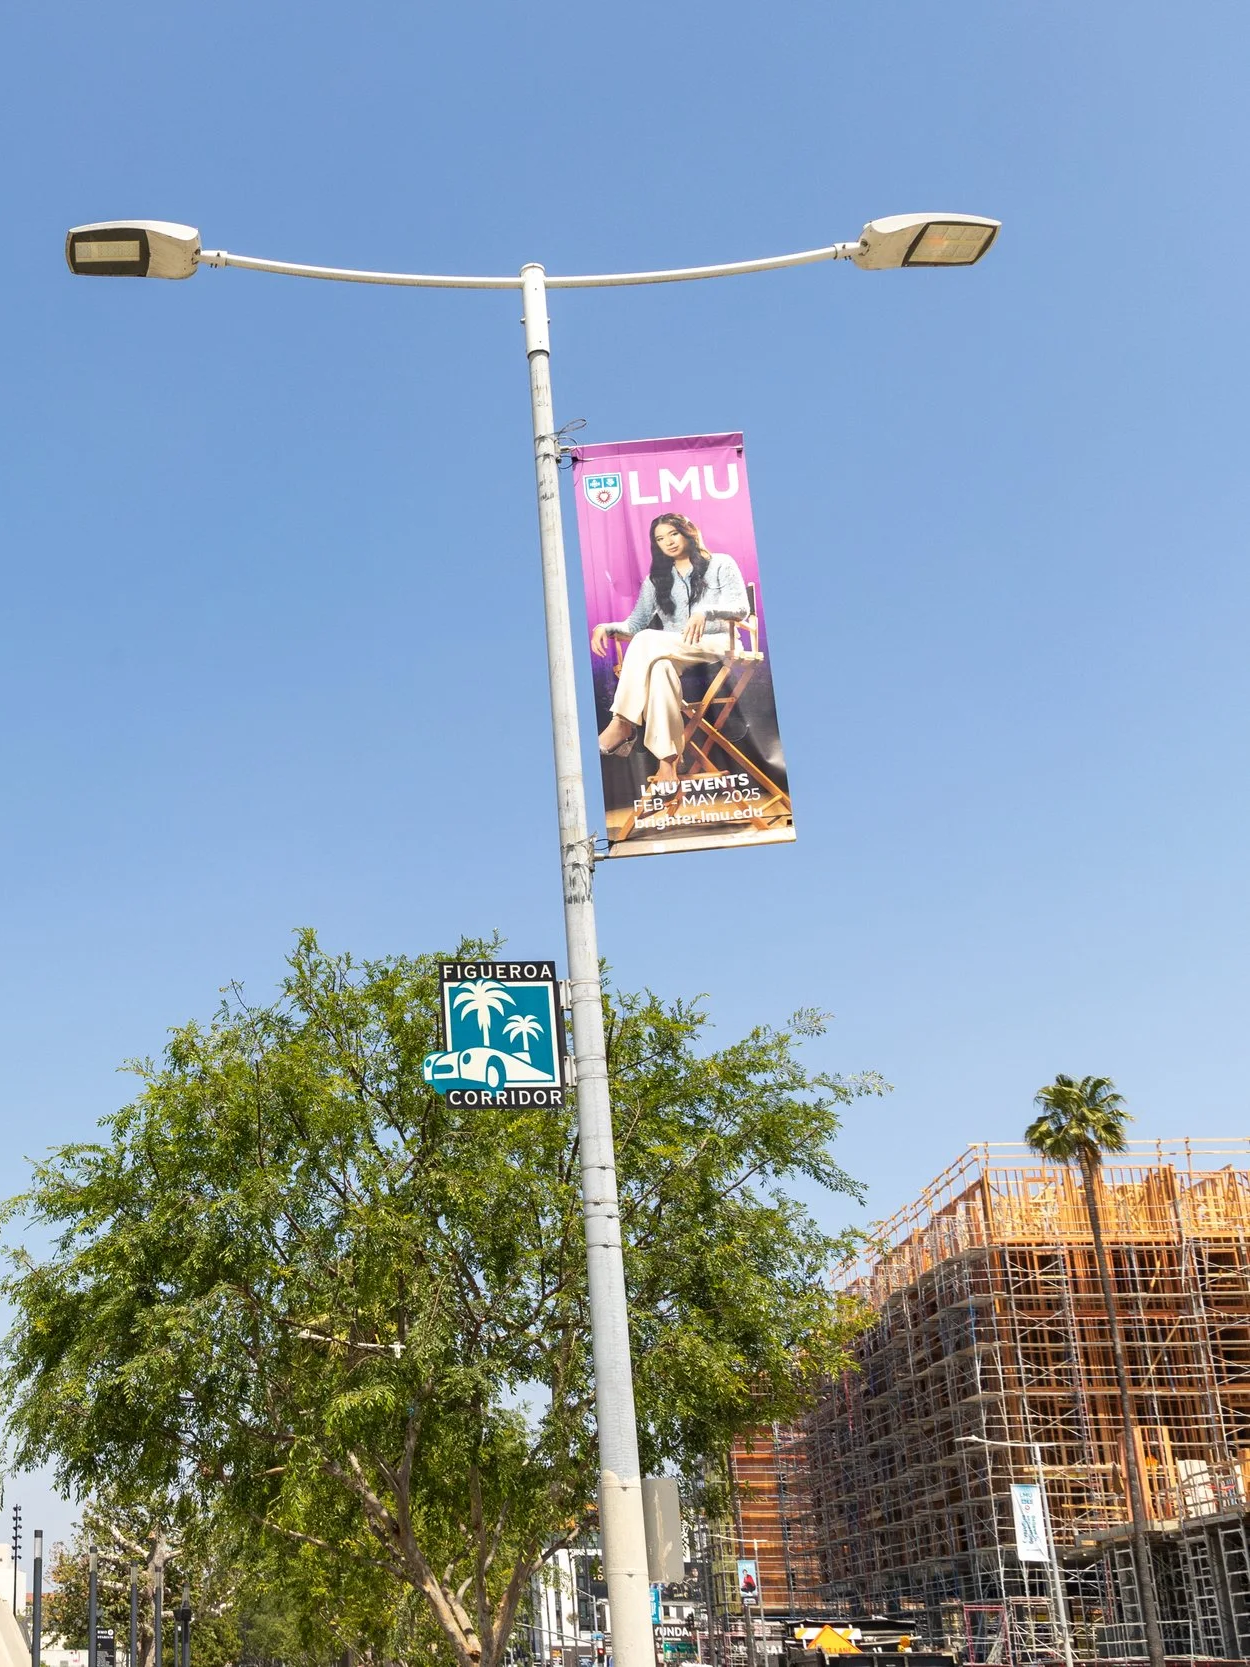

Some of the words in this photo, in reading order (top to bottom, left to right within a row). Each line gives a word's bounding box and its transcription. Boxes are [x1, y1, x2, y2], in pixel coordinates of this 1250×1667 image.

[628, 463, 739, 505] LMU
[640, 781, 679, 797] LMU
[680, 773, 750, 793] EVENTS
[633, 797, 668, 814] FEB.
[682, 791, 718, 808] MAY
[722, 787, 761, 804] 2025
[634, 804, 763, 830] brighter.lmu.edu
[442, 964, 553, 979] FIGUEROA
[449, 1090, 563, 1105] CORRIDOR
